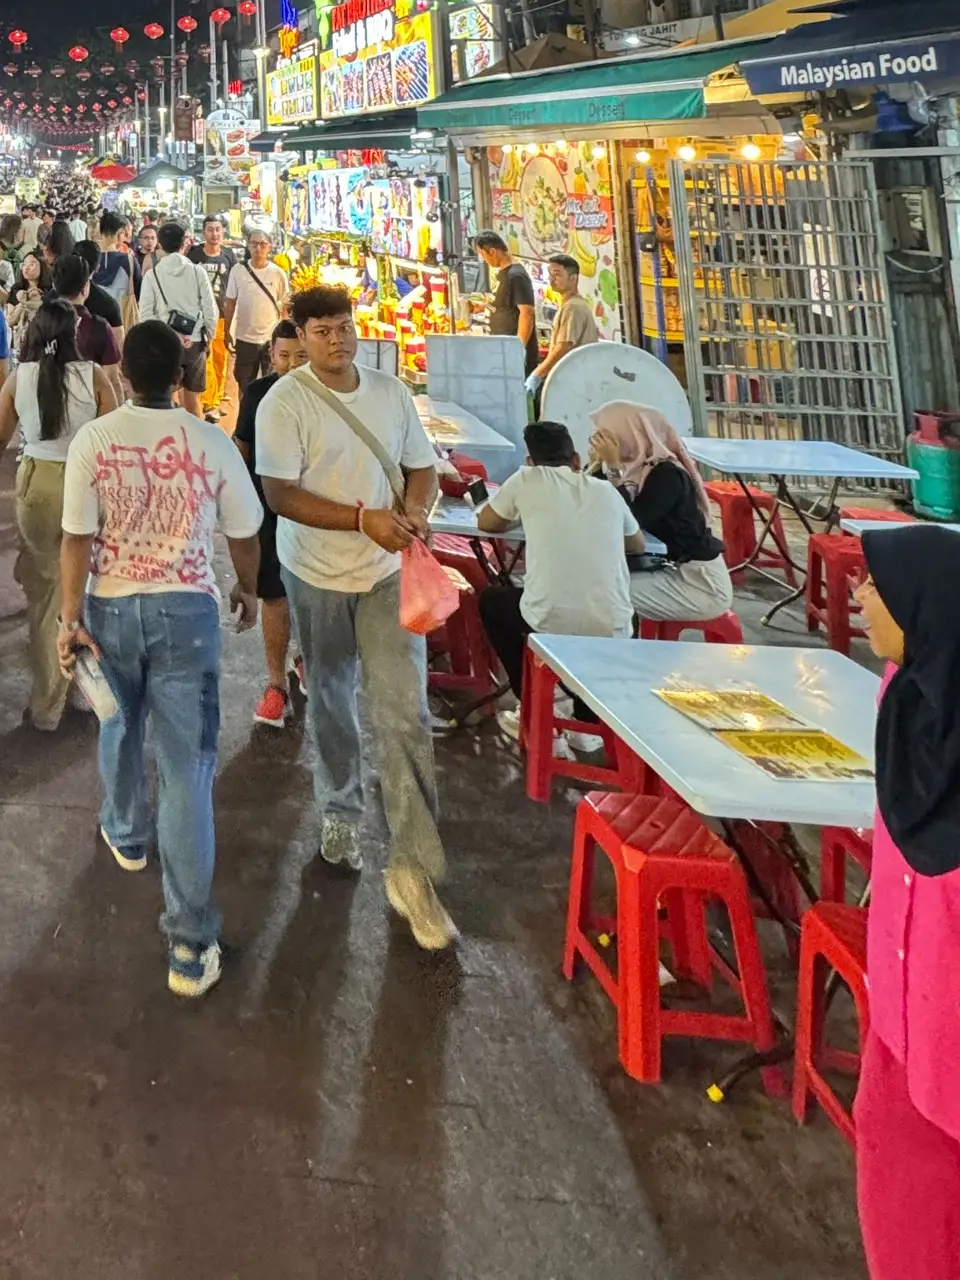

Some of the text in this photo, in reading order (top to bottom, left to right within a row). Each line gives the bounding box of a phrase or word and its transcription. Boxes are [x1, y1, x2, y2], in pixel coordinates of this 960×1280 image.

[649, 23, 678, 35] JAHIT
[780, 46, 938, 89] Malaysian Food
[589, 101, 625, 118] Dessert
